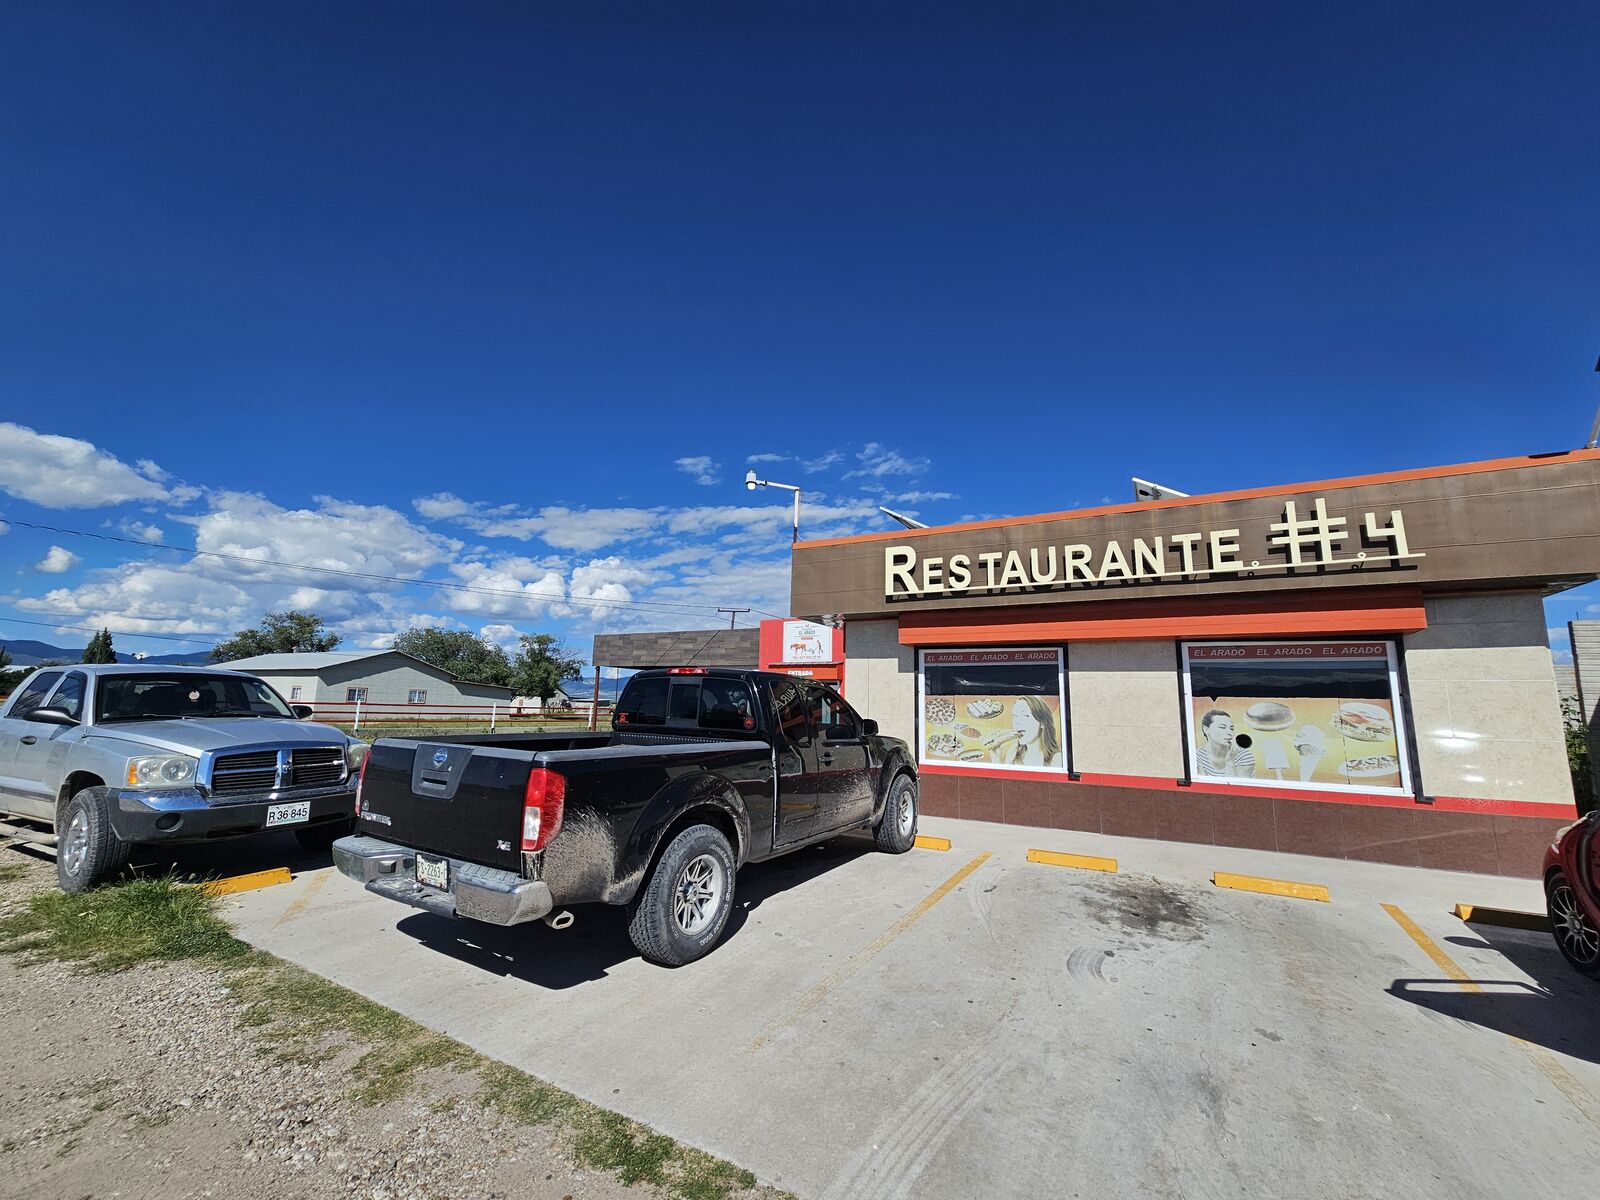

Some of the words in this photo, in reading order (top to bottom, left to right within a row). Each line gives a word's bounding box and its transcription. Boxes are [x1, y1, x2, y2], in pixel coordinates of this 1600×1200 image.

[885, 529, 1244, 595] RESTAURANTE
[1194, 649, 1206, 657] EL
[1210, 648, 1246, 656] ARADO
[1256, 648, 1270, 656] EL
[1274, 647, 1312, 655] ARADO
[1322, 647, 1337, 655] EL
[1341, 646, 1383, 655] ARADO
